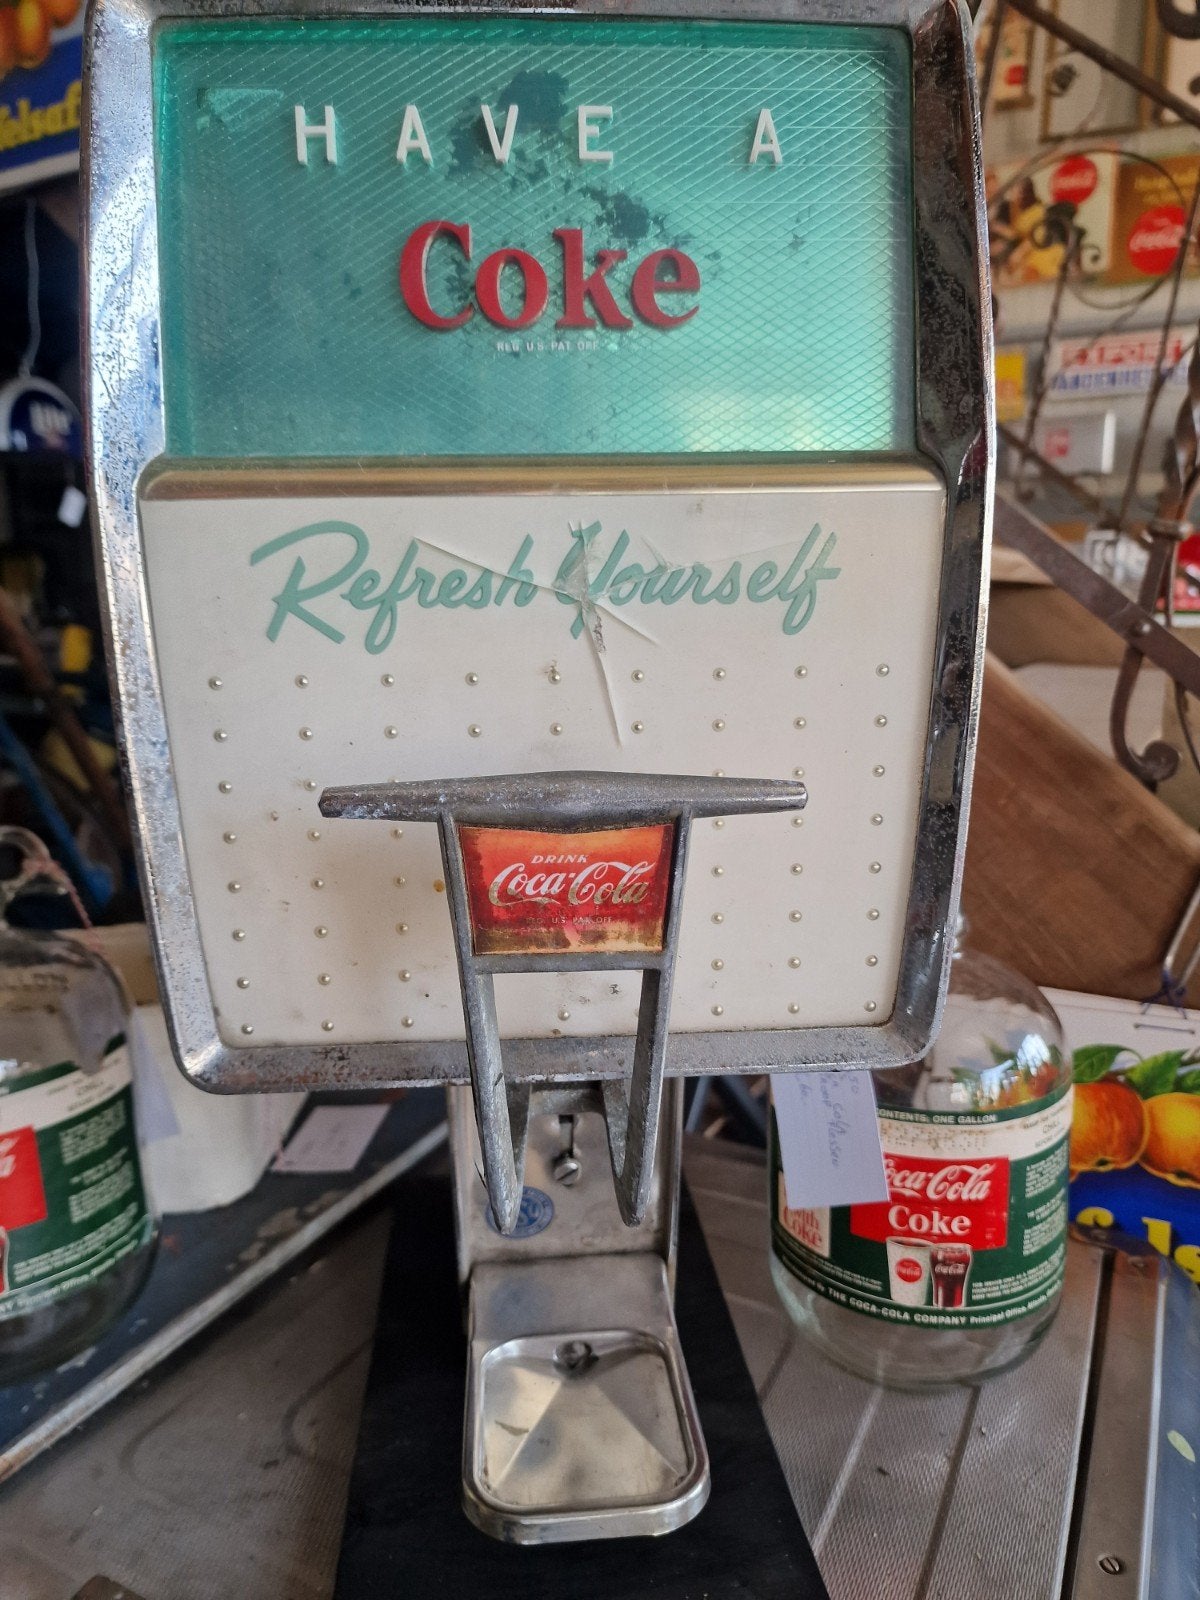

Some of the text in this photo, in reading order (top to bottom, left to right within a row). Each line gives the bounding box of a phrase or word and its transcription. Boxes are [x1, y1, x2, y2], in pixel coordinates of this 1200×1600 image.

[294, 104, 783, 166] HAVE A
[399, 220, 701, 331] Coke
[250, 520, 842, 655] Refresh Yourself
[531, 854, 589, 864] DRINK
[488, 861, 656, 907] Coca-Cola
[876, 1108, 996, 1124] ONTENTS: ONE GALLON
[888, 1205, 972, 1236] Coke
[827, 1286, 847, 1301] THE
[849, 1297, 911, 1321] COCA-COLA
[913, 1313, 966, 1325] COMPANY
